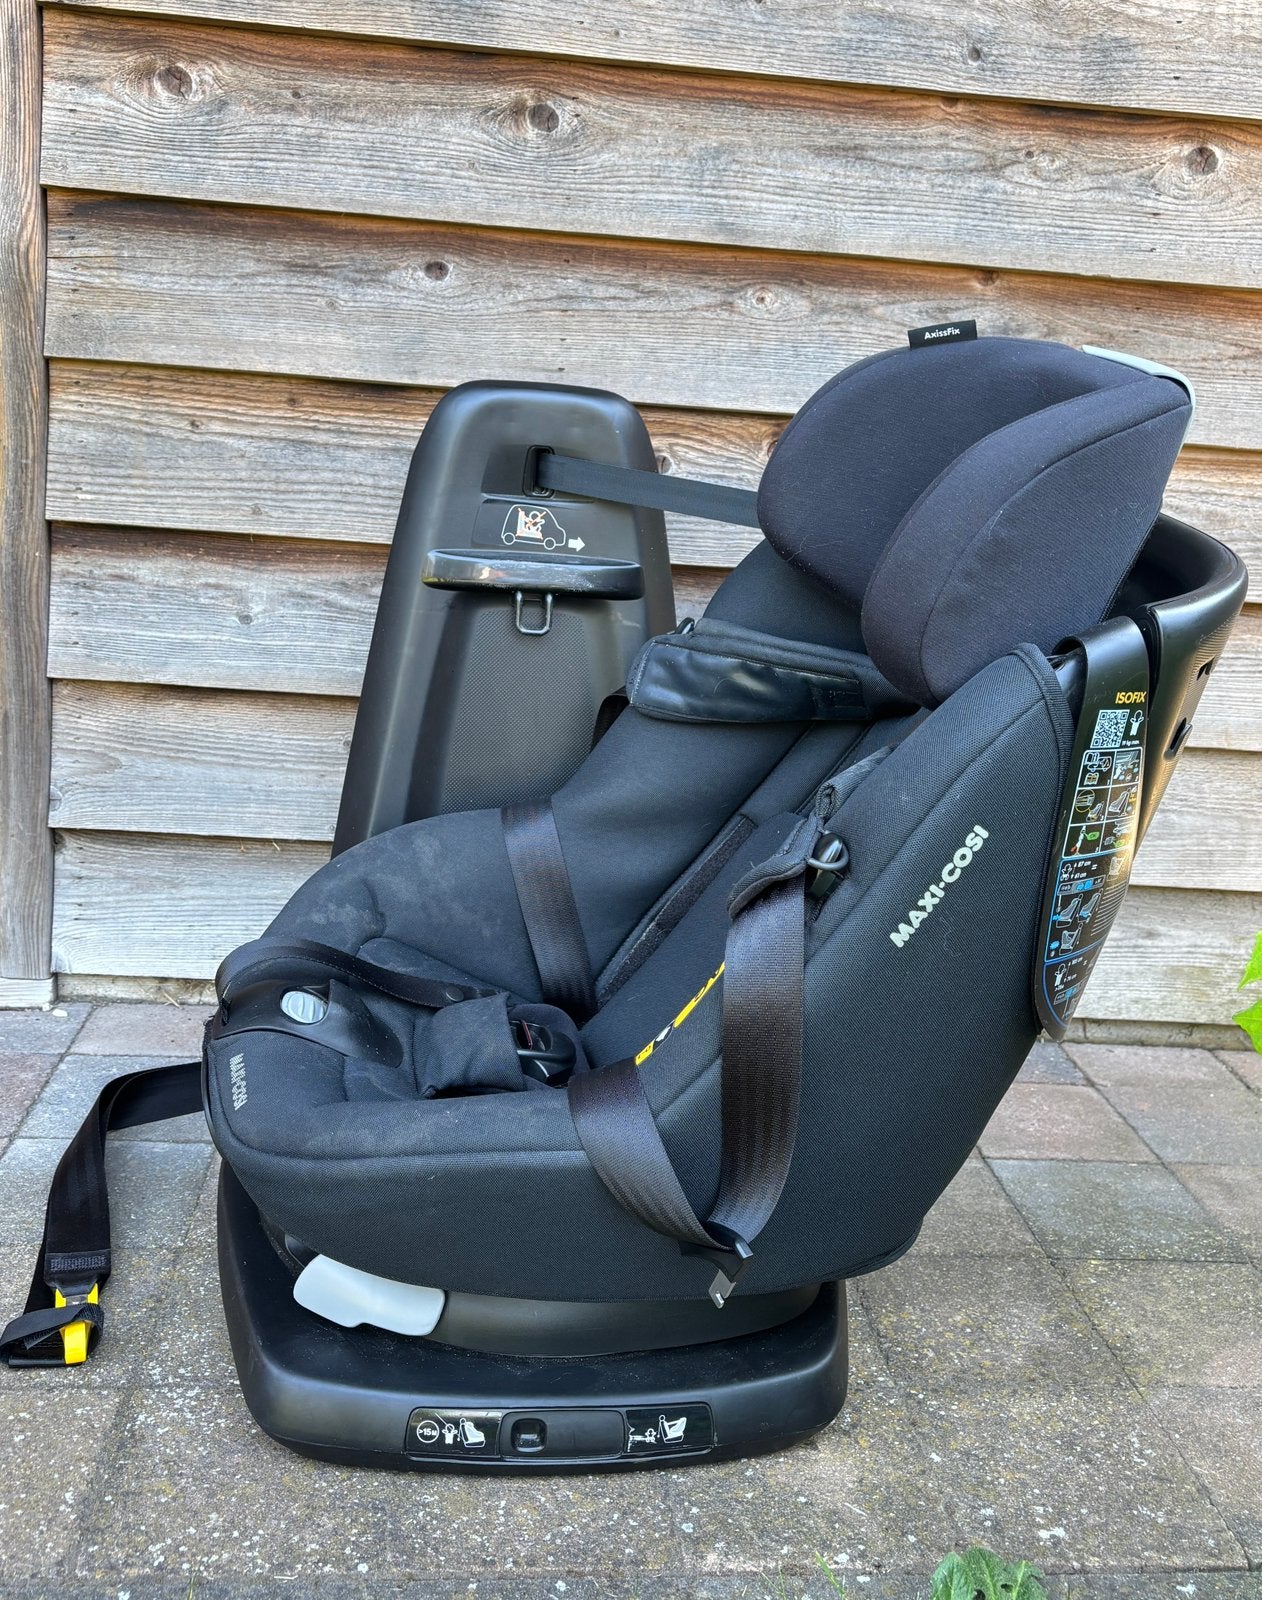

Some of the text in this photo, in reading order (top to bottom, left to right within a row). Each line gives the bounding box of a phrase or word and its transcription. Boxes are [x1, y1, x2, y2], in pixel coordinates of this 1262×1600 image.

[924, 327, 960, 340] AxissFix
[1115, 691, 1147, 704] ISOFIX
[889, 825, 989, 947] MAXI-COSI
